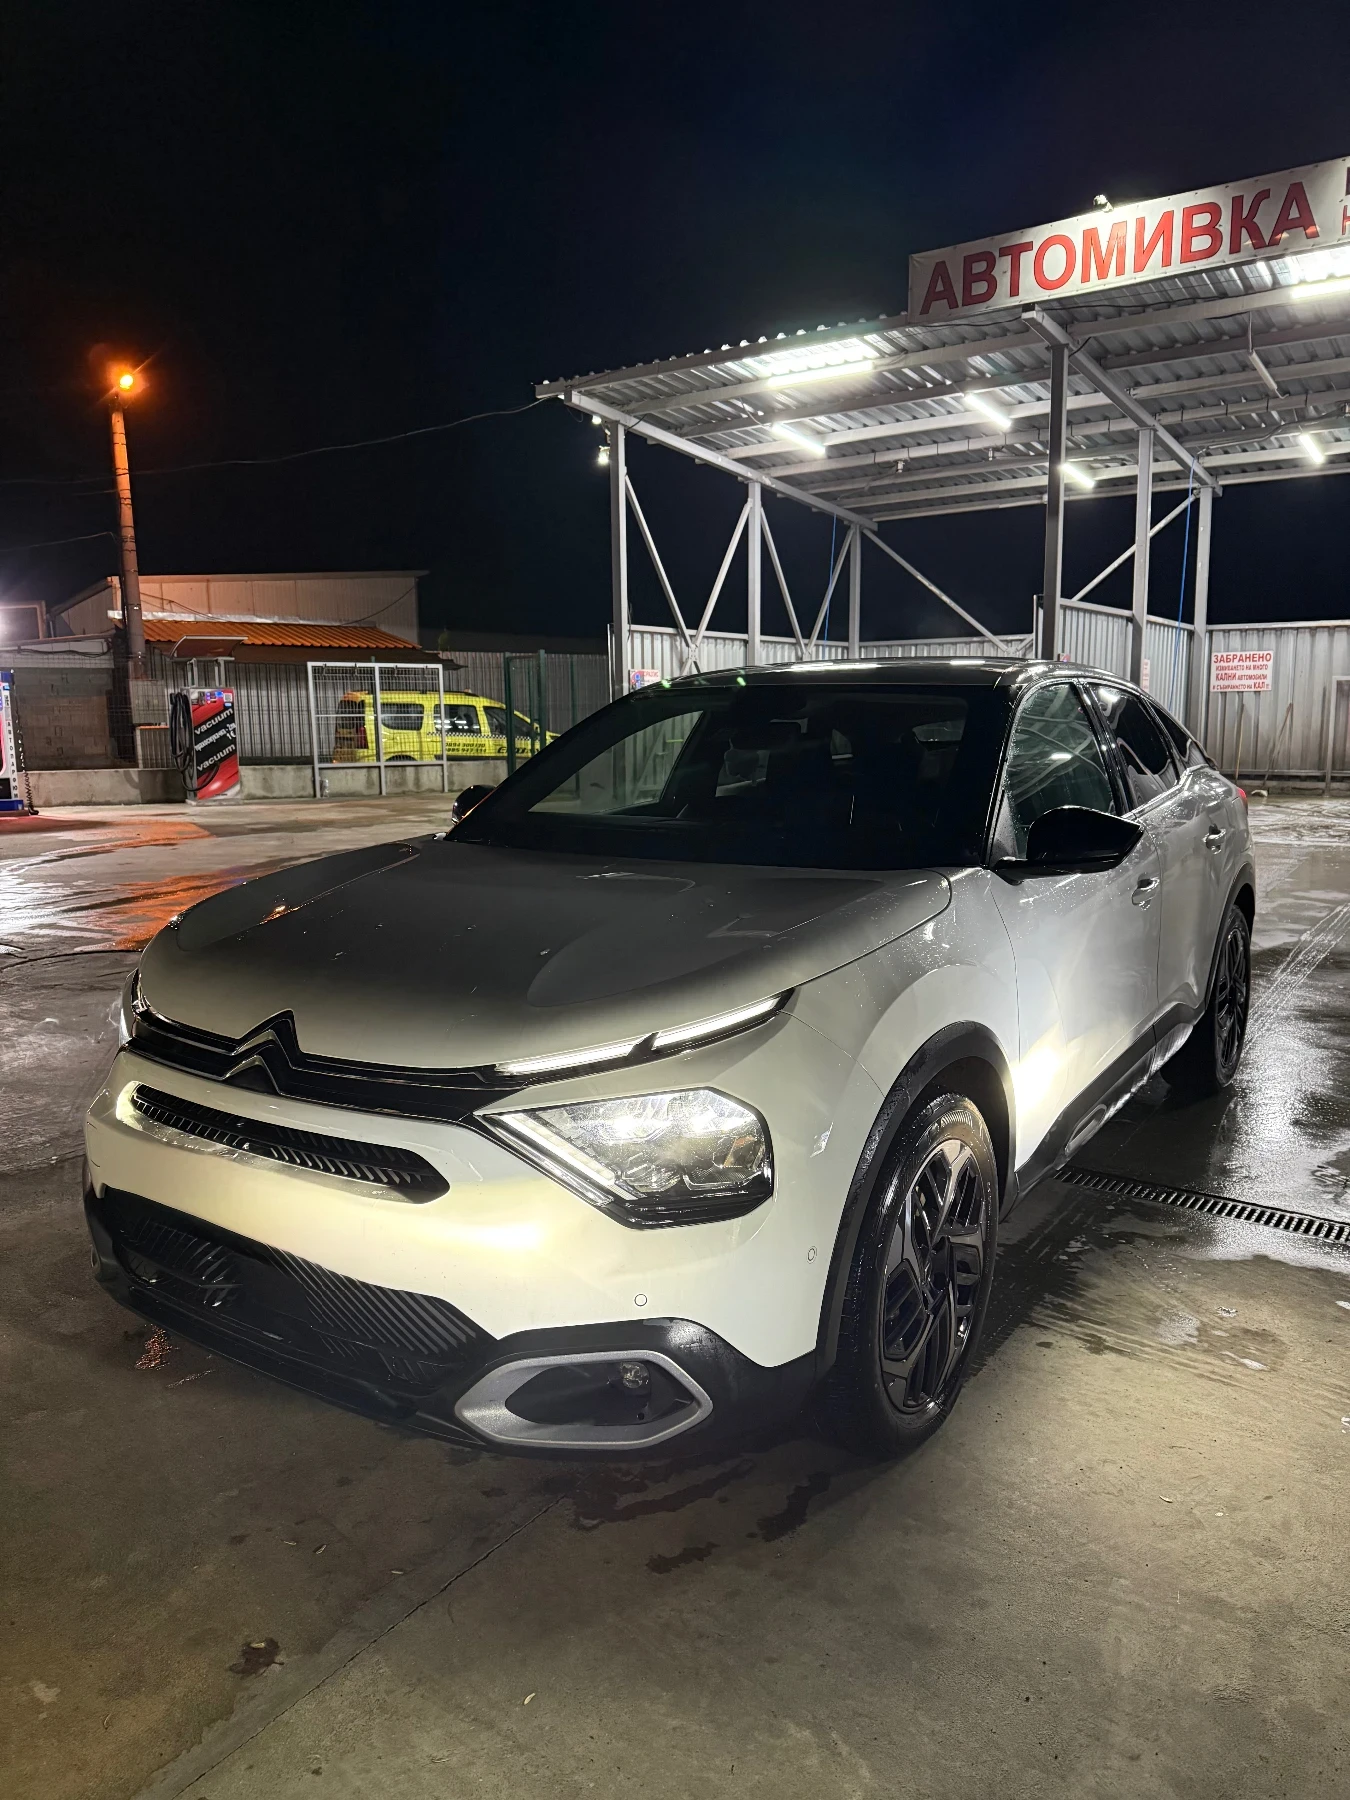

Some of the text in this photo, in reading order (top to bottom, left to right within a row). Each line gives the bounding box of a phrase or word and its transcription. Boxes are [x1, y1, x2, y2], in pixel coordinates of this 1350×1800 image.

[919, 182, 1320, 315] АВТОМИВКА
[1213, 653, 1272, 664] ЗАБРАНЕНО
[1215, 673, 1237, 682] КАЛНИ
[1253, 682, 1265, 690] КАЛ
[194, 708, 234, 735] vacuum
[196, 743, 236, 771] vacuum
